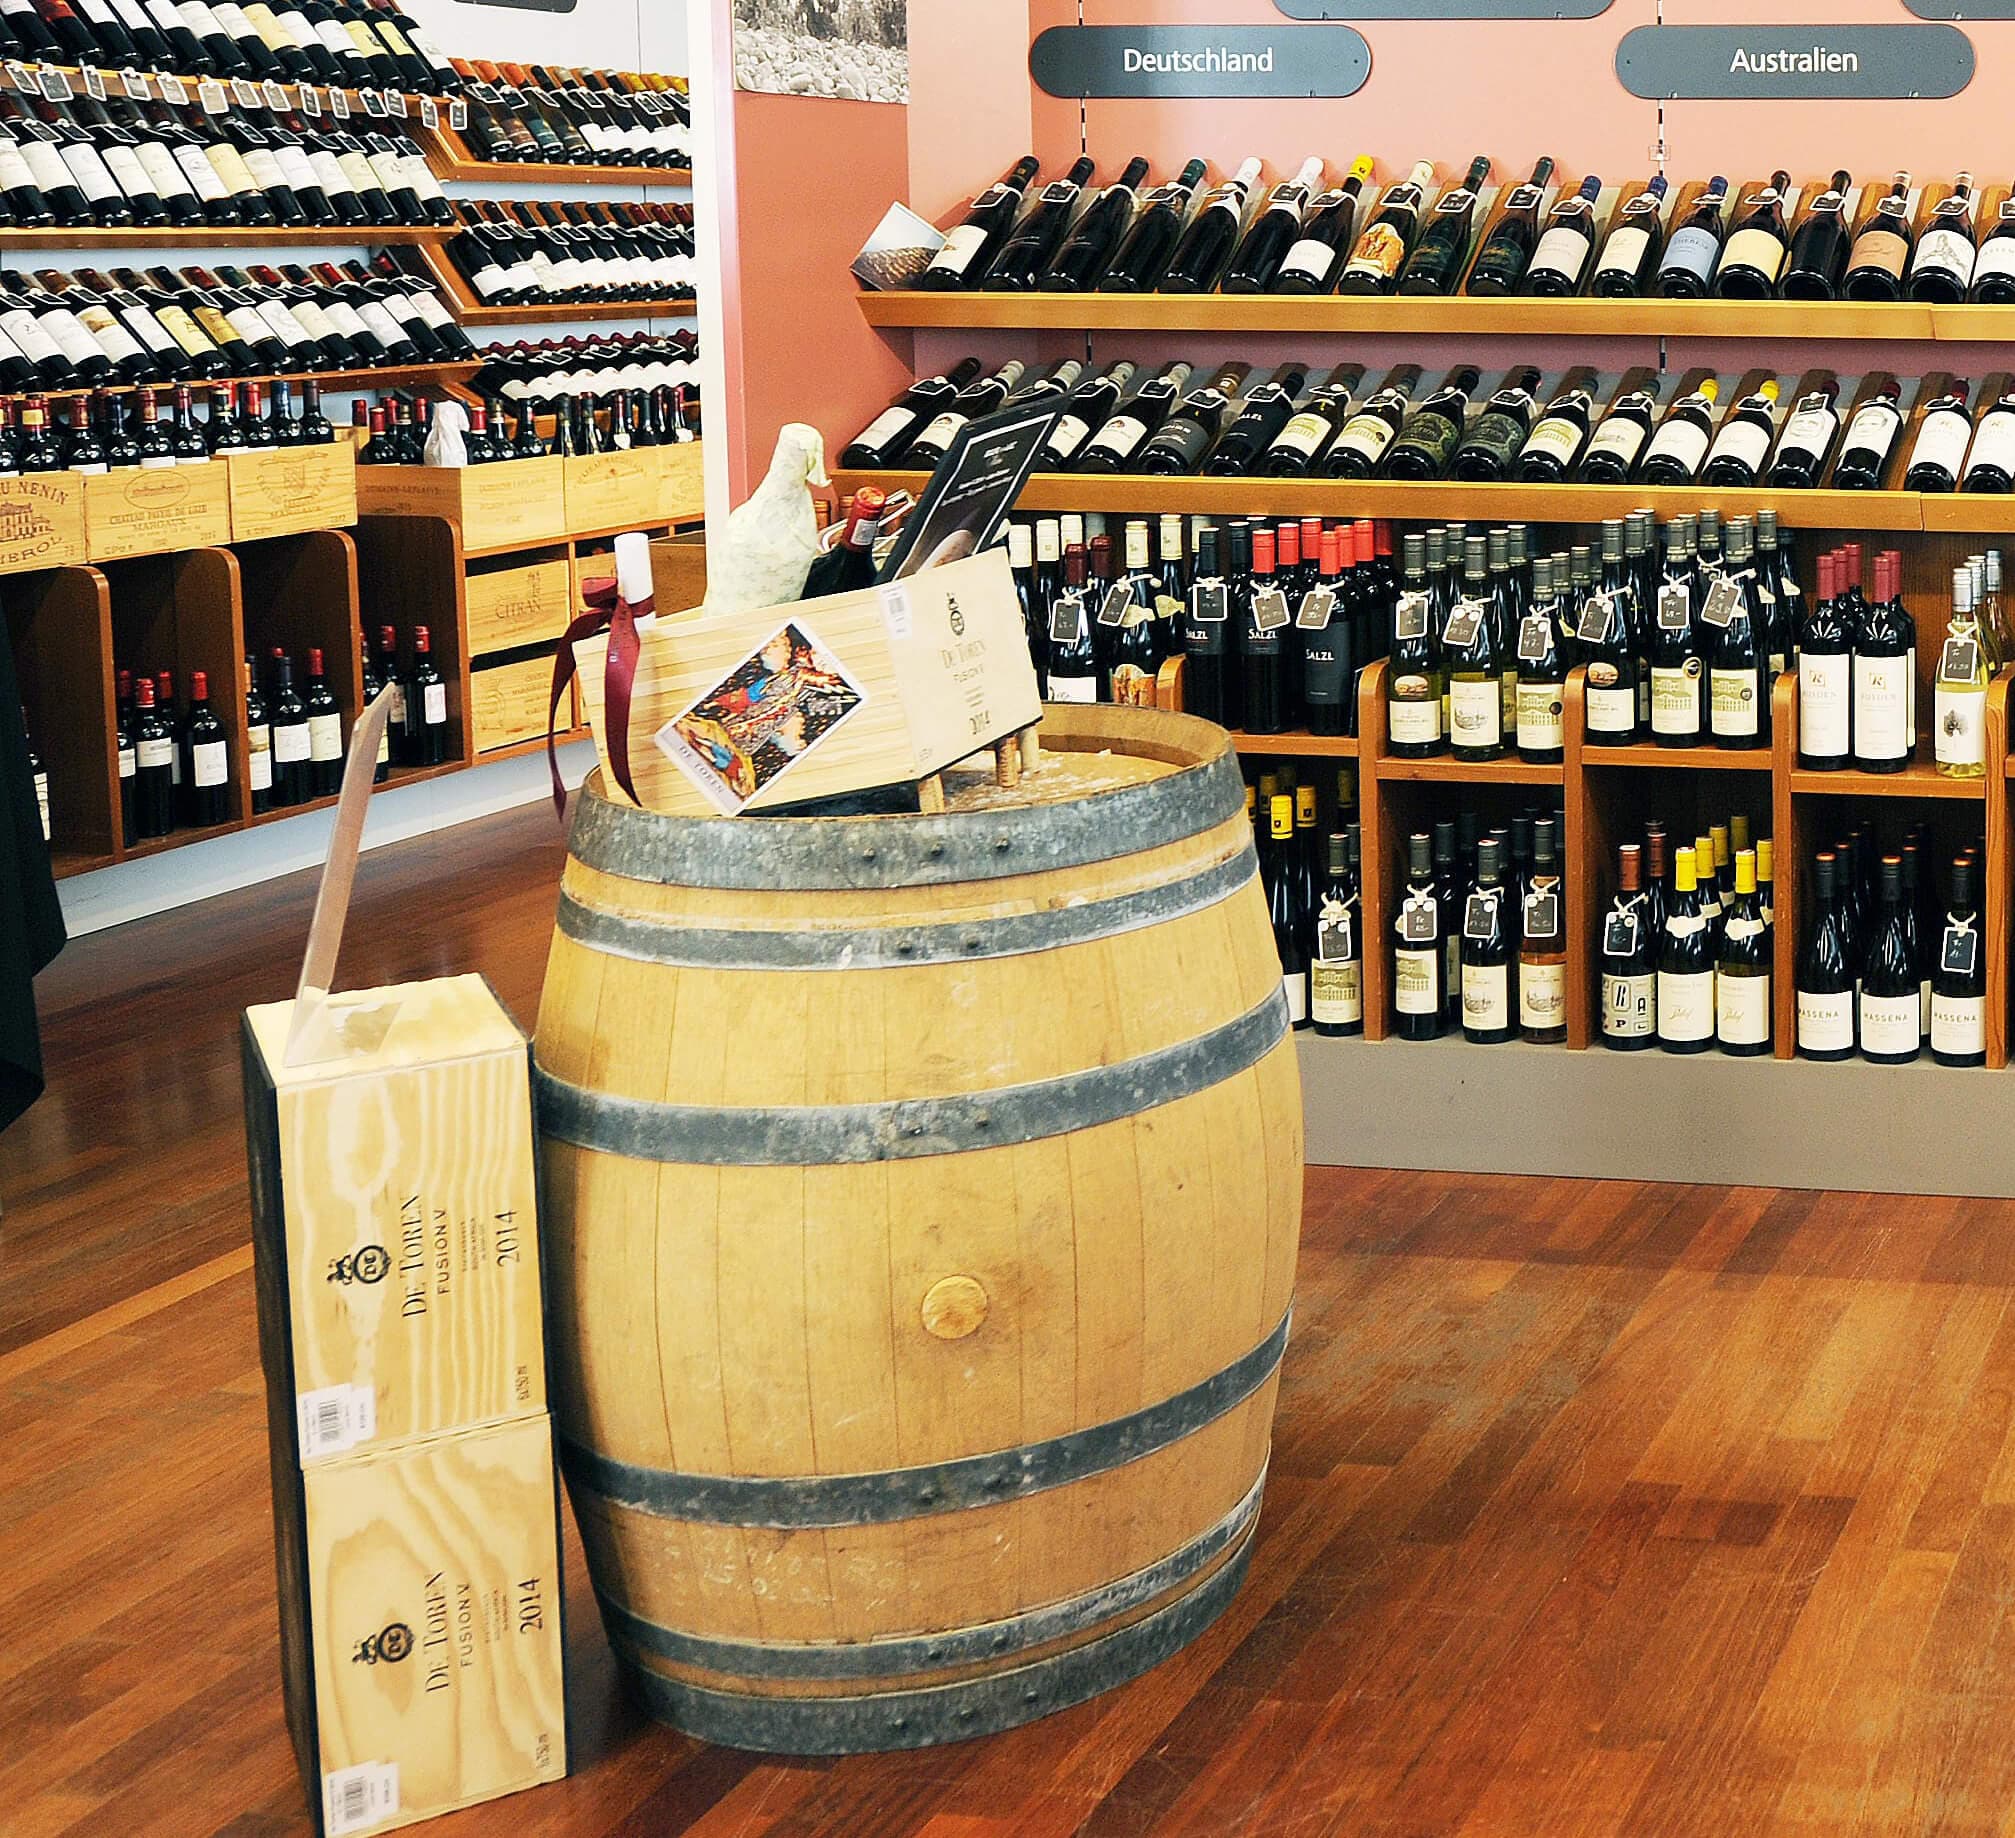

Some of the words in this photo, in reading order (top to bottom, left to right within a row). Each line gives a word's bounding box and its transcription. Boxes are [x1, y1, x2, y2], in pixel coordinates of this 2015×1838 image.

[1123, 47, 1273, 72] Deutschland
[1729, 47, 1859, 72] Australien
[18, 481, 69, 505] NENIN
[495, 599, 541, 619] CITRAN
[1248, 629, 1278, 640] SALZL
[1306, 648, 1335, 661] SALZL
[433, 1208, 447, 1221] V
[400, 1195, 424, 1278] TOREN
[494, 1209, 520, 1268] 2014
[434, 1224, 450, 1294] FUSION
[402, 1281, 427, 1317] DE
[457, 1583, 470, 1595] V
[423, 1570, 448, 1655] TOREN
[518, 1576, 543, 1634] 2014
[457, 1598, 473, 1668] FUSION
[425, 1656, 449, 1692] DE
